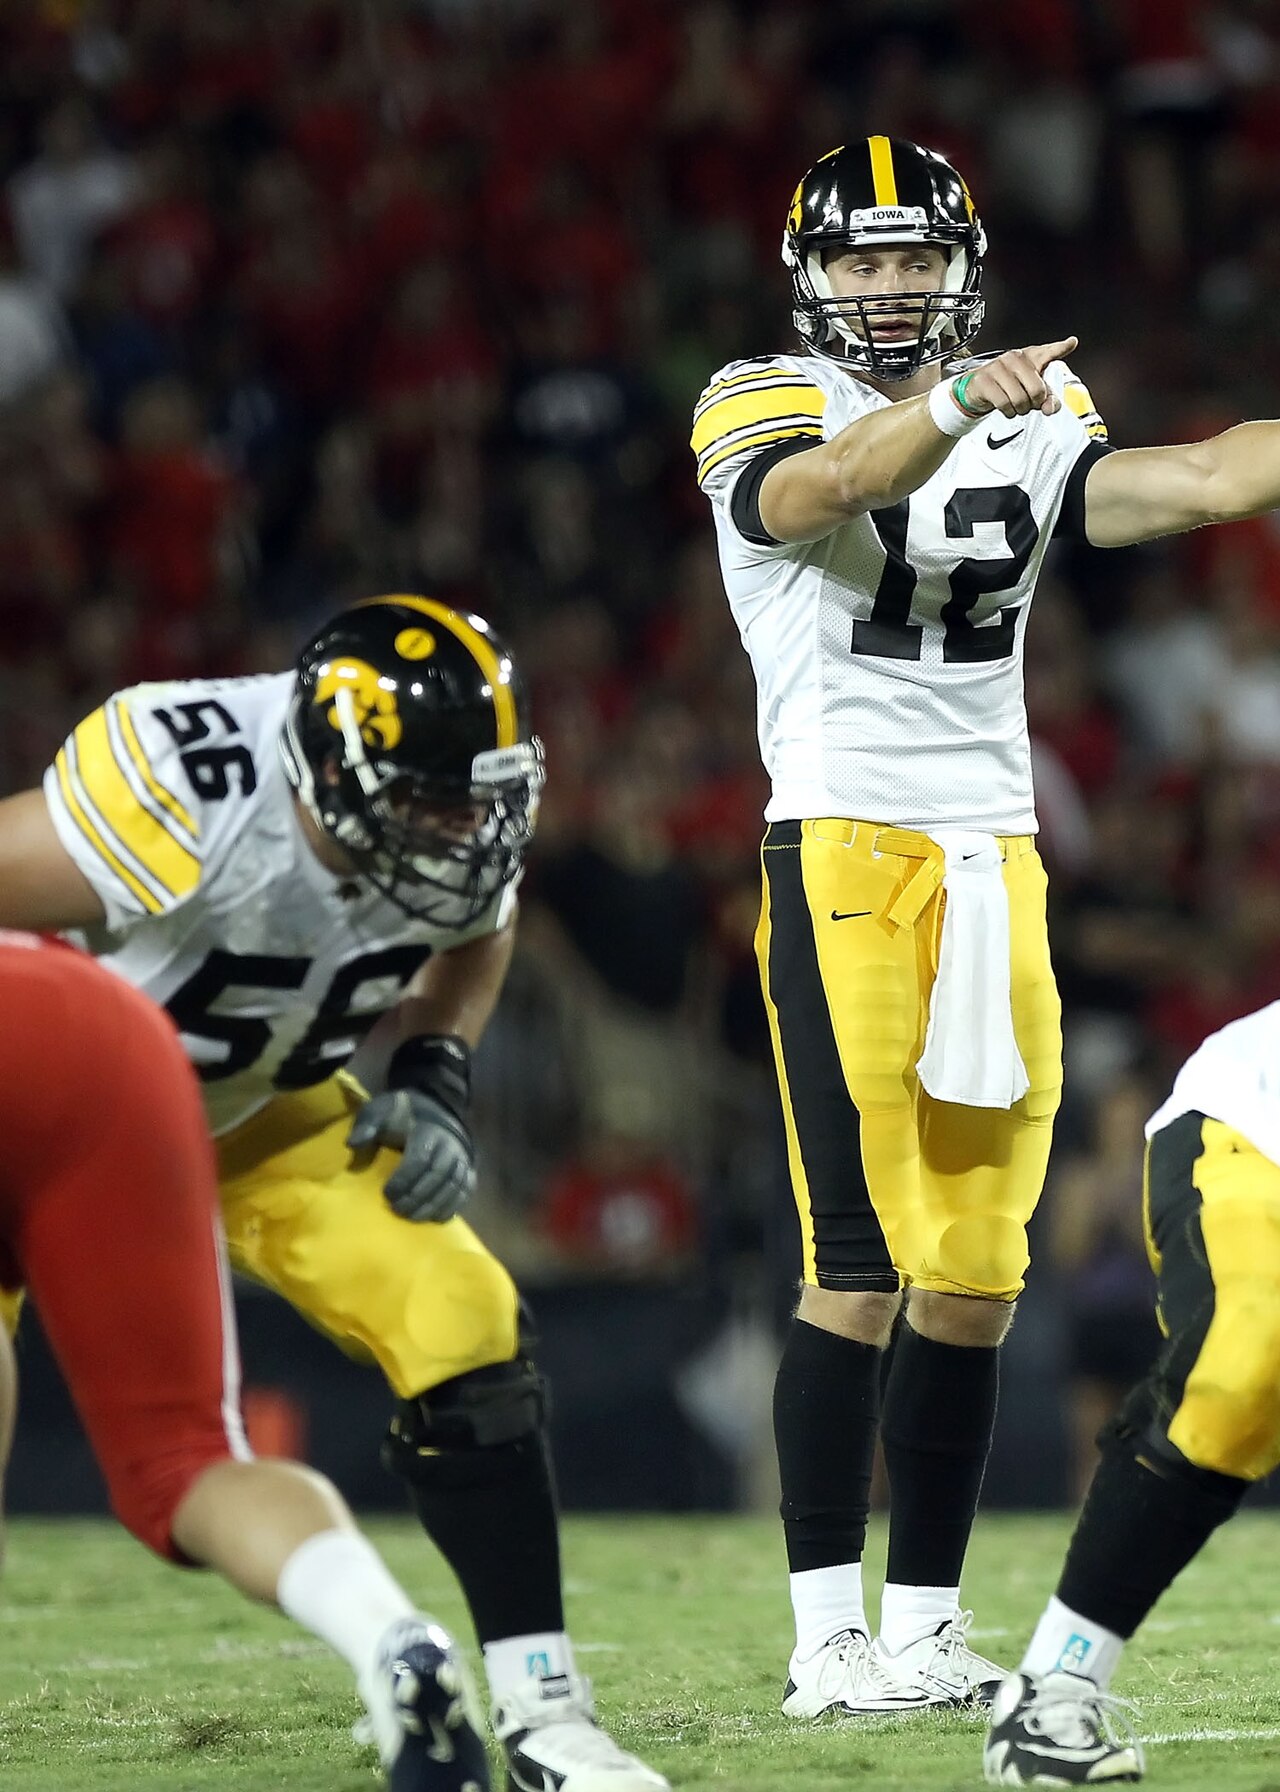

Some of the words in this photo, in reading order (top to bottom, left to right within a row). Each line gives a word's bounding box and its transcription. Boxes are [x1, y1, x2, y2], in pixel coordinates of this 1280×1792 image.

[872, 210, 905, 220] IOWA
[850, 484, 1039, 663] 12
[151, 700, 257, 801] 56
[165, 943, 432, 1091] 56
